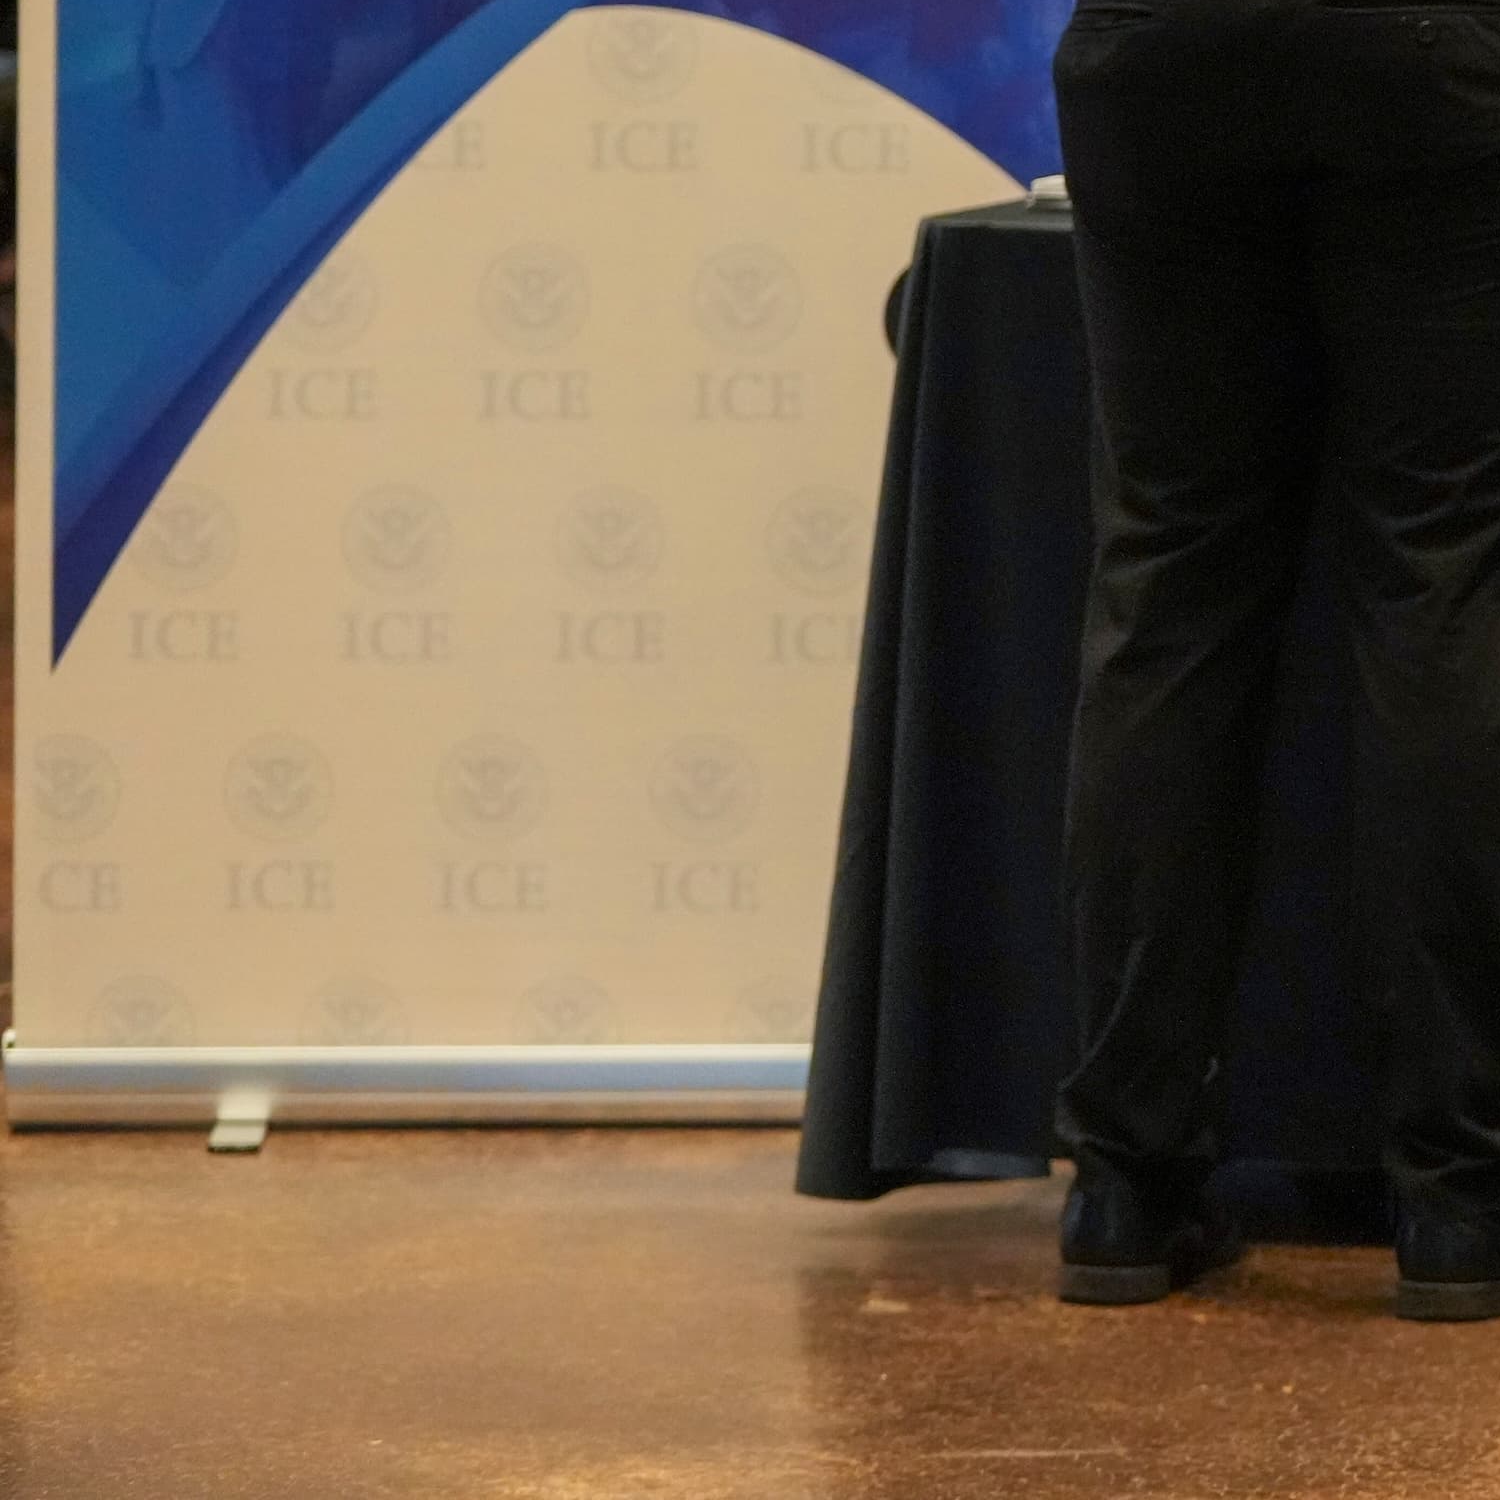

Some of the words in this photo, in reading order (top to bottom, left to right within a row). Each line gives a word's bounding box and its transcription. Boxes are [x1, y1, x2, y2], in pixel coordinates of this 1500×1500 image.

[587, 121, 699, 173] ICE
[800, 123, 911, 175] ICE
[265, 367, 379, 422] ICE
[476, 368, 591, 422] ICE
[694, 370, 804, 422] ICE
[128, 610, 239, 664] ICE
[338, 610, 455, 664] ICE
[552, 610, 668, 664] ICE
[222, 860, 336, 913] ICE
[435, 861, 549, 914] ICE
[649, 861, 762, 914] ICE
